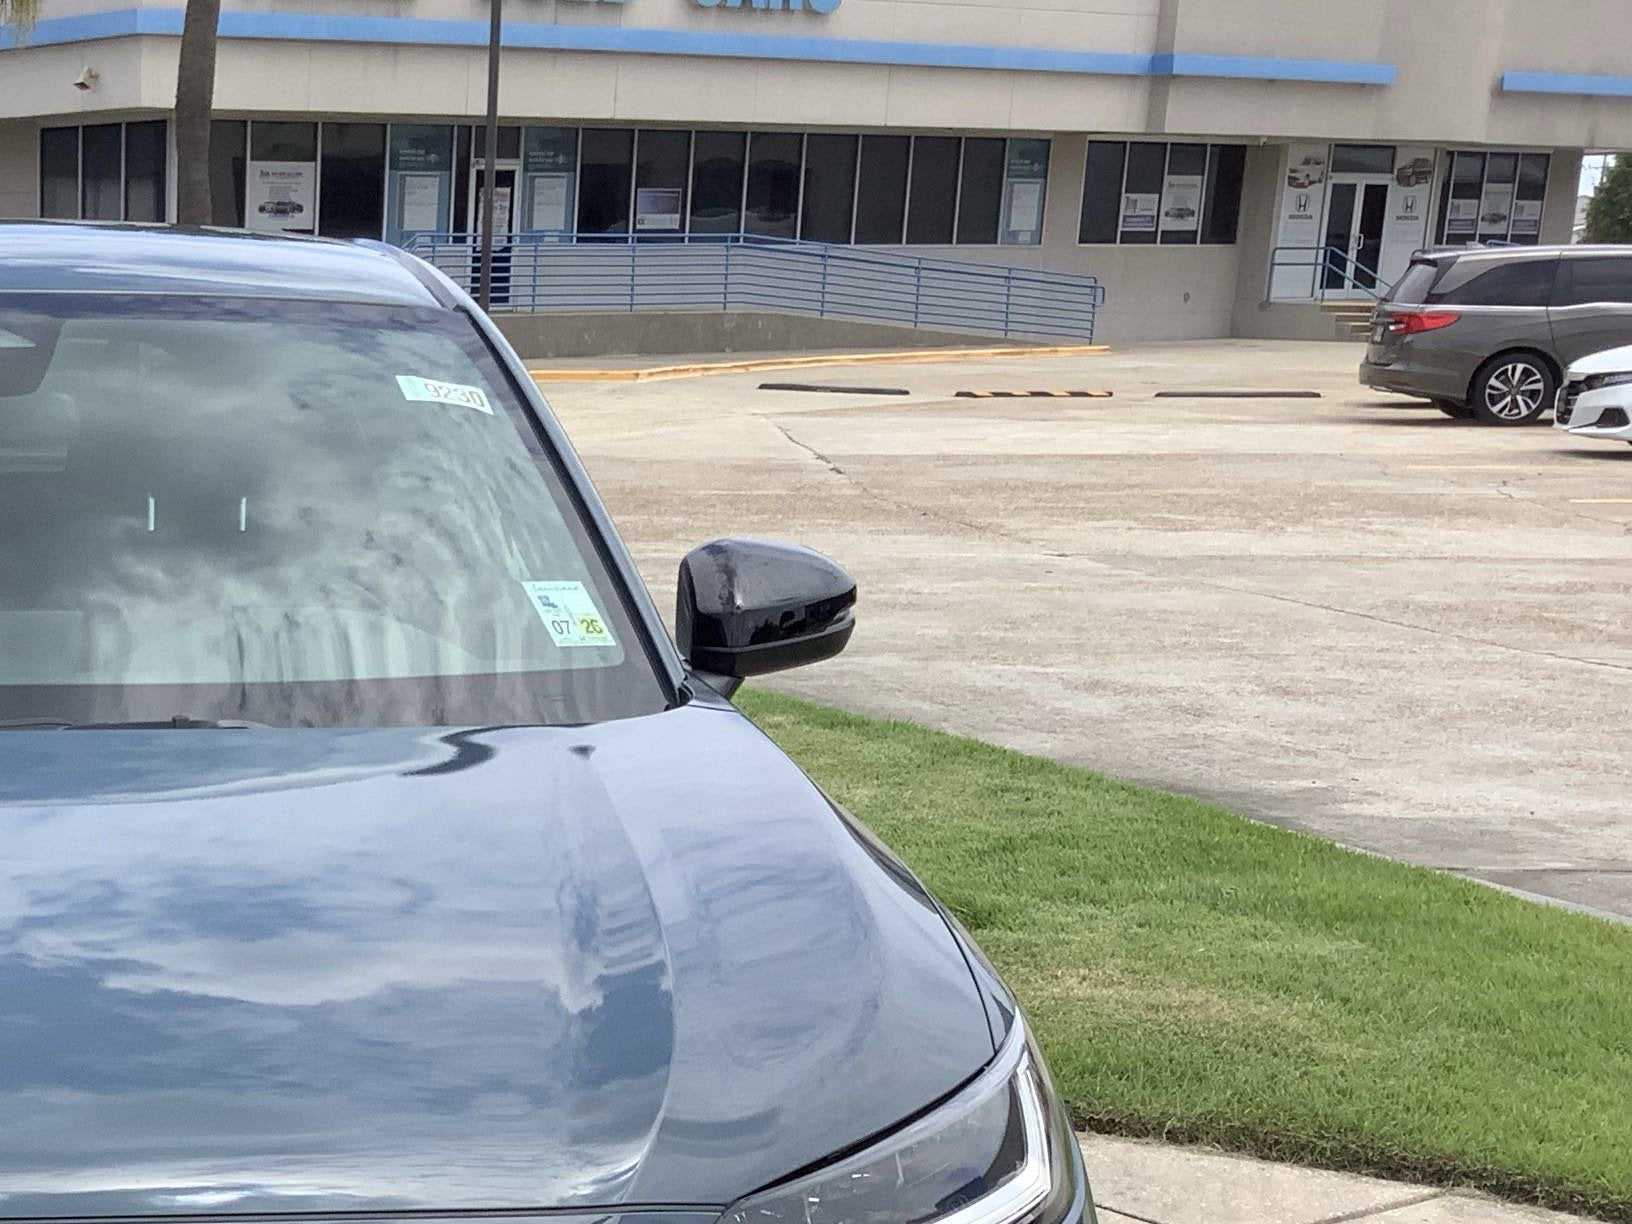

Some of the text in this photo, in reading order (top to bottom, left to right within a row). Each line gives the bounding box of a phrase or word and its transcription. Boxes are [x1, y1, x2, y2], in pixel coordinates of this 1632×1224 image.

[423, 383, 485, 408] 9230
[551, 619, 603, 634] 07 26
